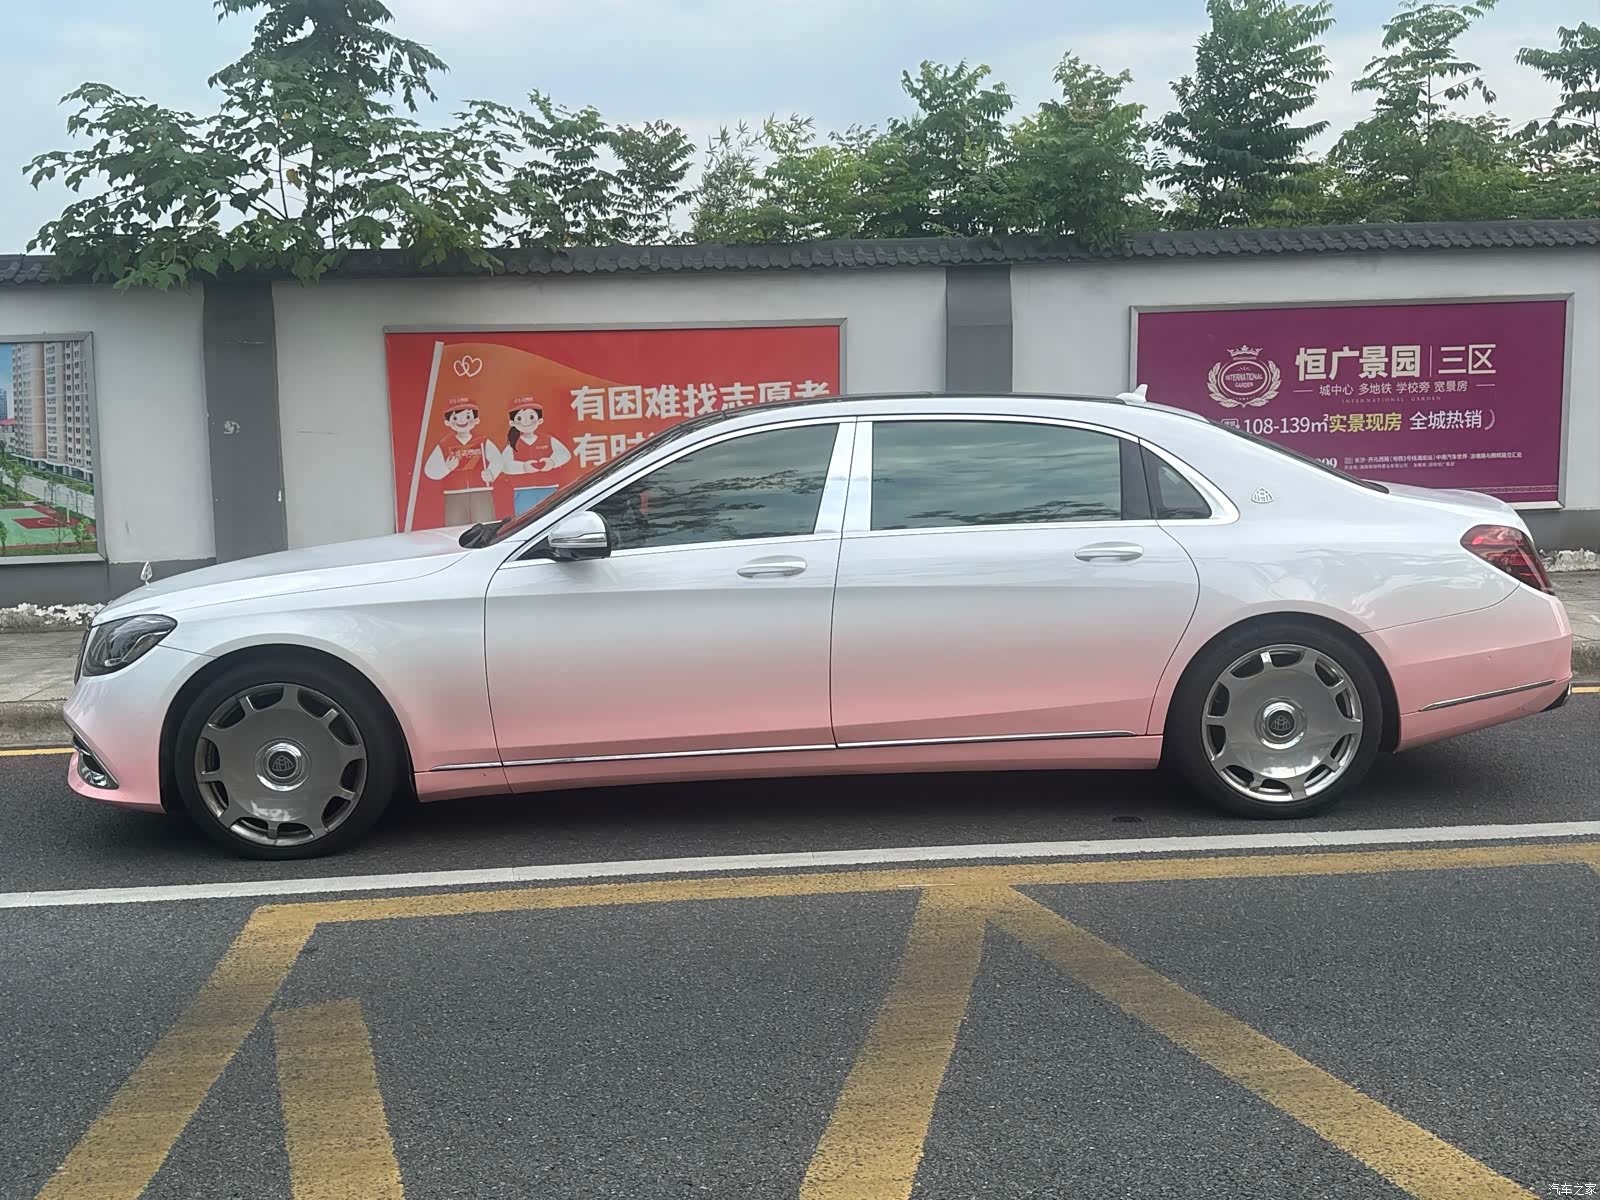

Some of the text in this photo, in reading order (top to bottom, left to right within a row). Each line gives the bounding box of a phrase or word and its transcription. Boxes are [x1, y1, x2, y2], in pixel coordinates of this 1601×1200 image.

[1295, 343, 1497, 381] 恒广景园 三区
[1225, 373, 1263, 381] INTERNATIONAL
[1319, 380, 1468, 396] 城中心 多地铁 学校旁 宽景房
[1409, 409, 1482, 430] 全城热销
